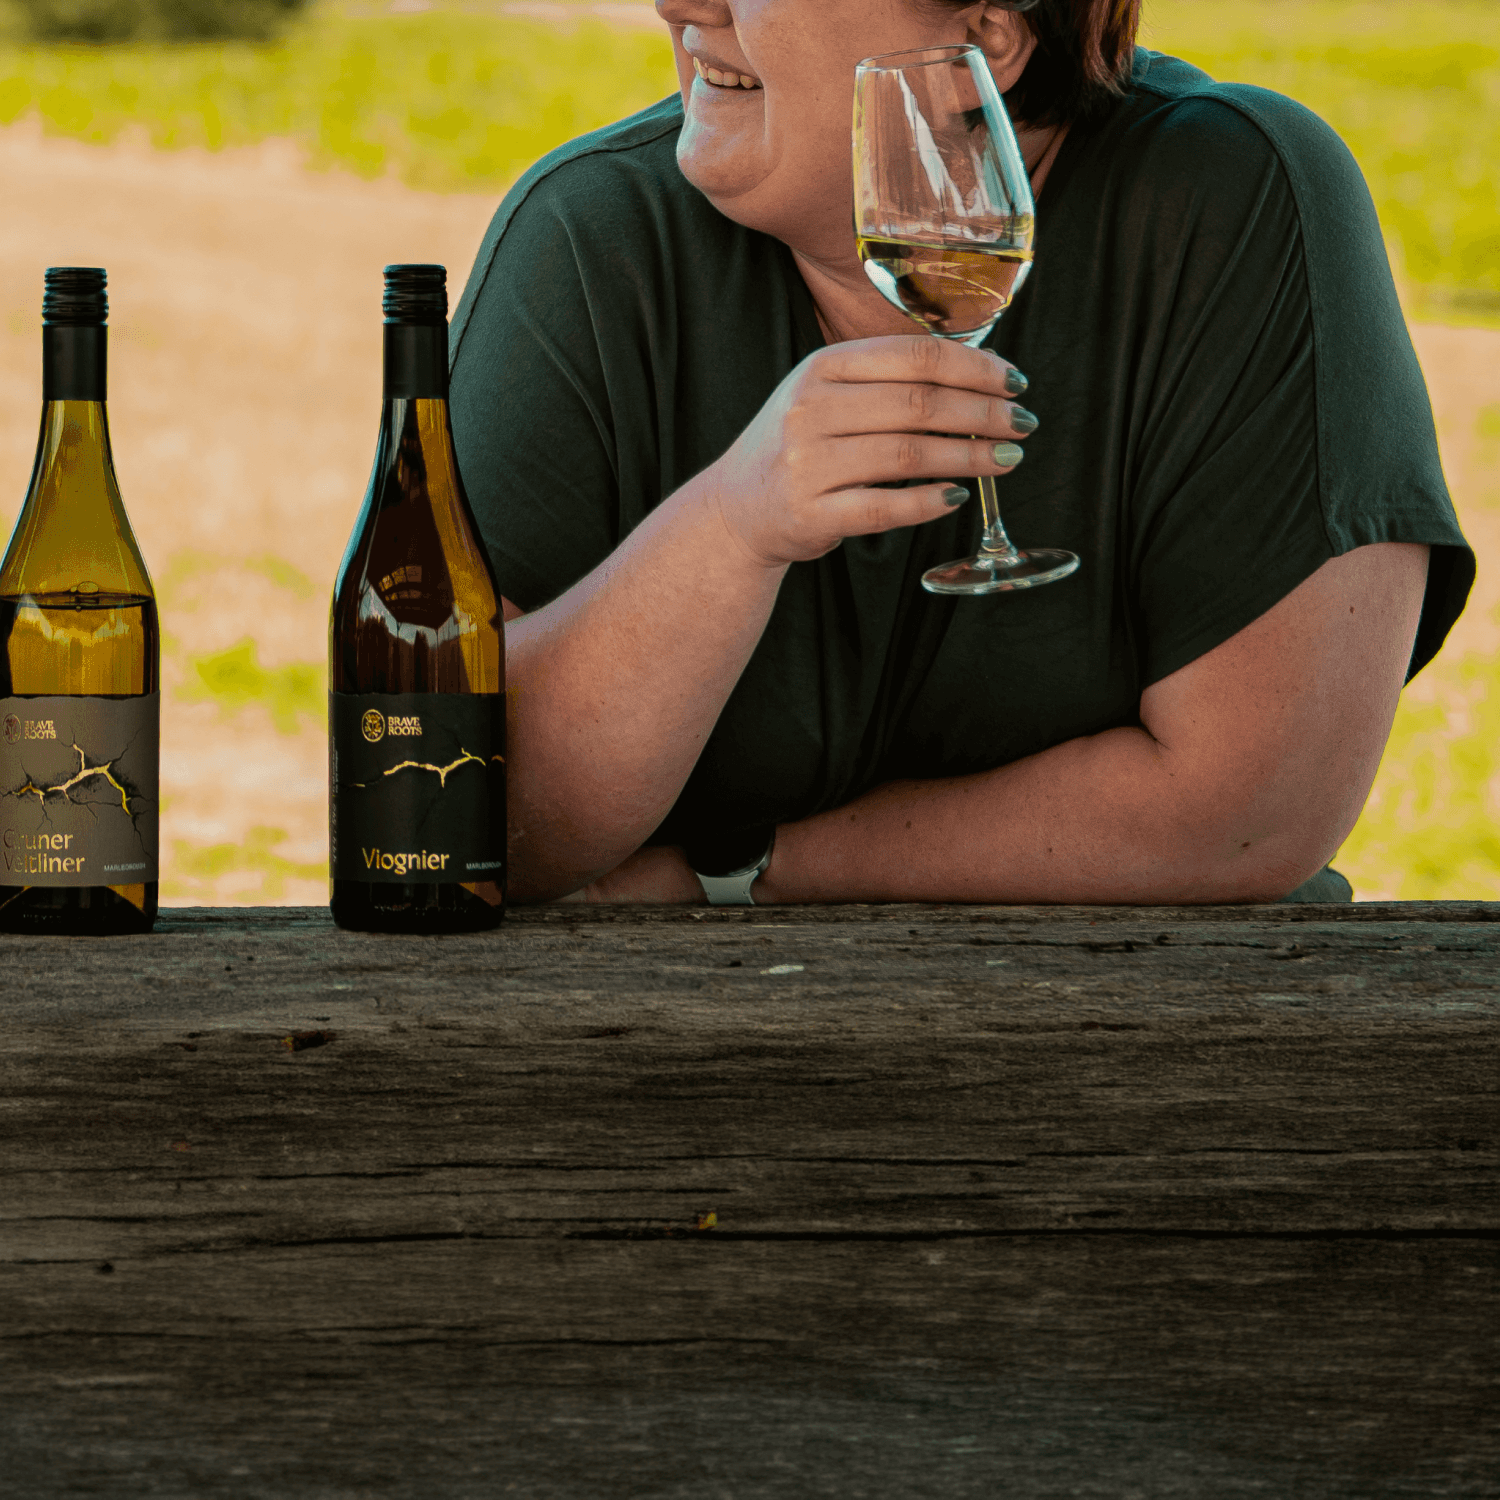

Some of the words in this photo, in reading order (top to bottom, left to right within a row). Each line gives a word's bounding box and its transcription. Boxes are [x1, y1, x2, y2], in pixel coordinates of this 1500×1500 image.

[24, 720, 54, 730] BRAVE
[387, 716, 420, 726] BRAVE
[24, 729, 57, 740] ROOTS
[387, 726, 423, 736] ROOTS
[3, 851, 86, 873] Veltliner
[361, 847, 450, 875] Viognier
[103, 862, 147, 872] MARLBOROUGH
